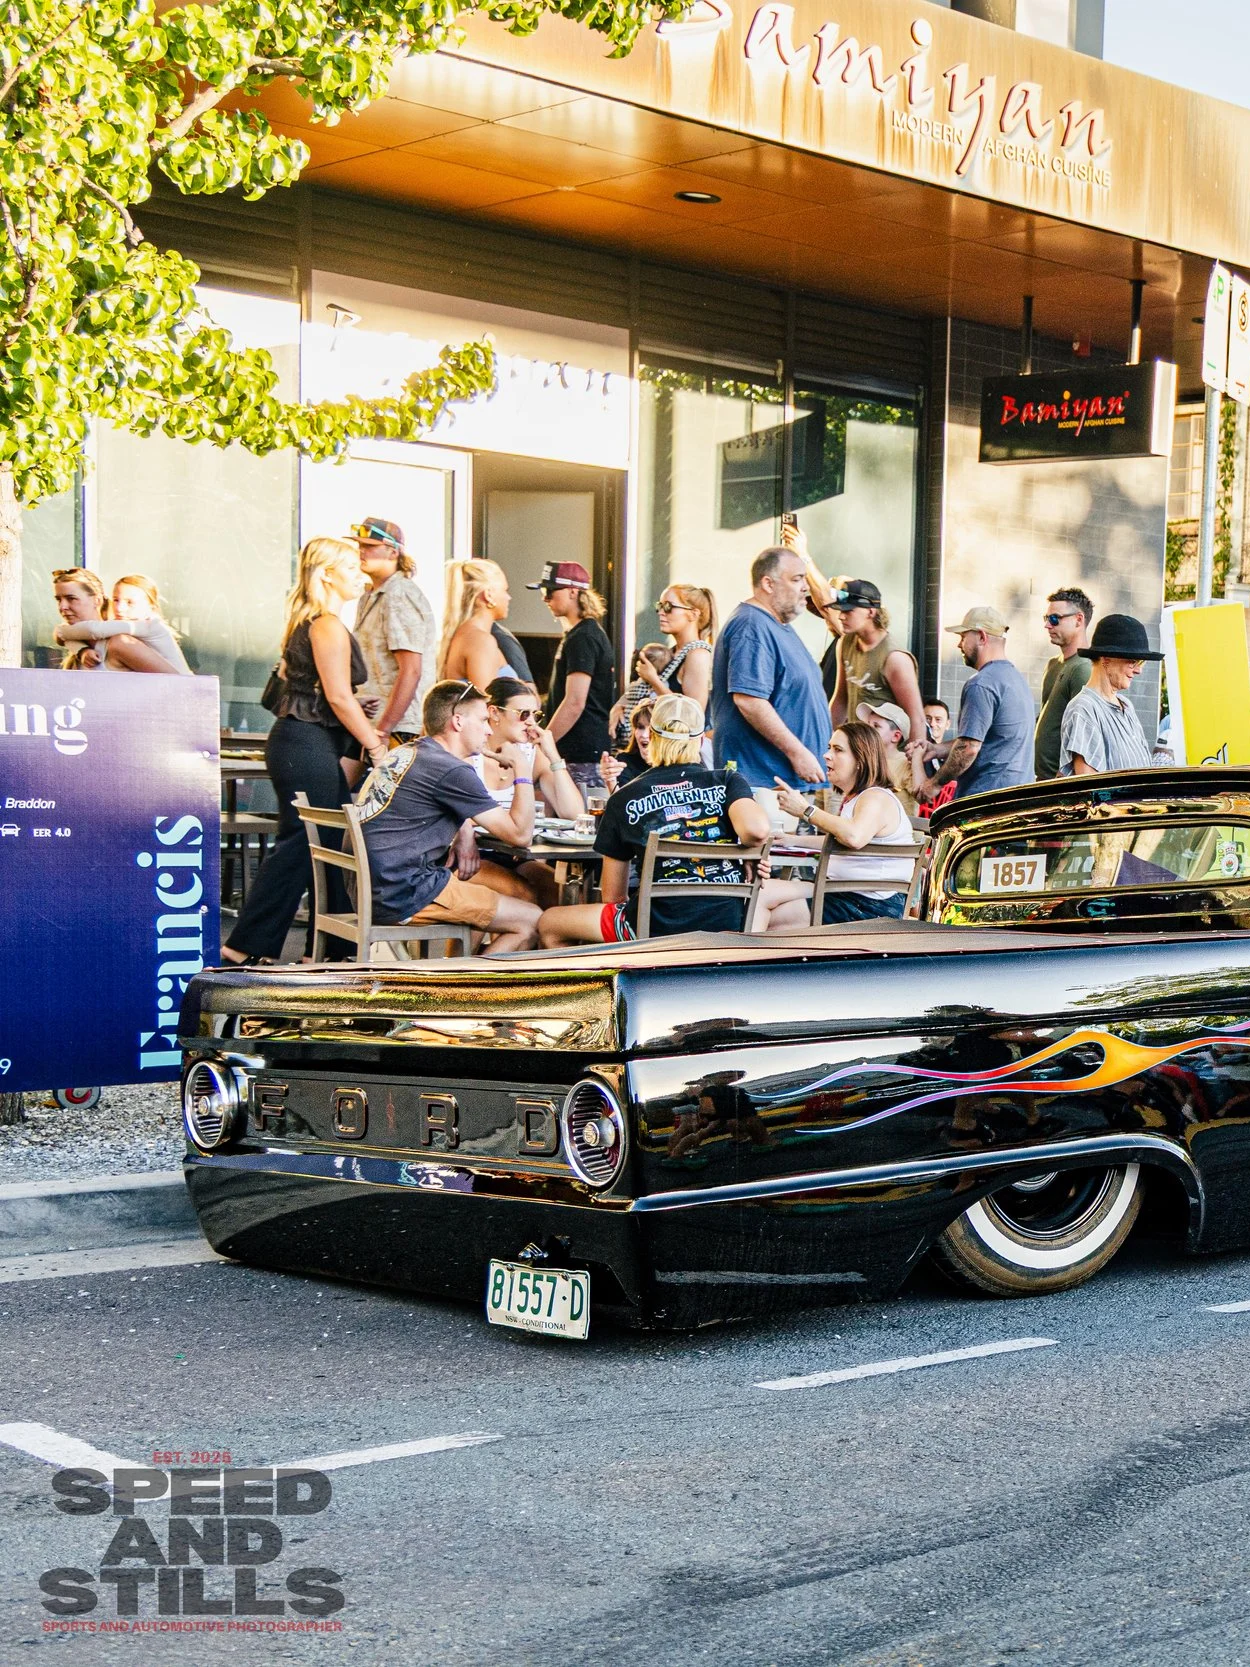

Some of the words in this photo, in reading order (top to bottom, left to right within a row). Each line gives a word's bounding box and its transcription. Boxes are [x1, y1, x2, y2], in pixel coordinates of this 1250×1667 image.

[656, 0, 1113, 176] amiyan
[891, 110, 964, 145] MODERN
[983, 139, 1046, 169] AFGHAN
[1051, 155, 1112, 189] CUISINE
[1000, 390, 1126, 437] Bamiyan
[5, 797, 56, 809] Braddon
[626, 785, 727, 824] SUMMERNATS
[33, 828, 52, 838] EER
[55, 827, 72, 838] 4.0
[992, 861, 1038, 887] 1857
[253, 1082, 561, 1156] FORD
[505, 1315, 518, 1323] NSW
[522, 1318, 567, 1331] CONDITIONAL
